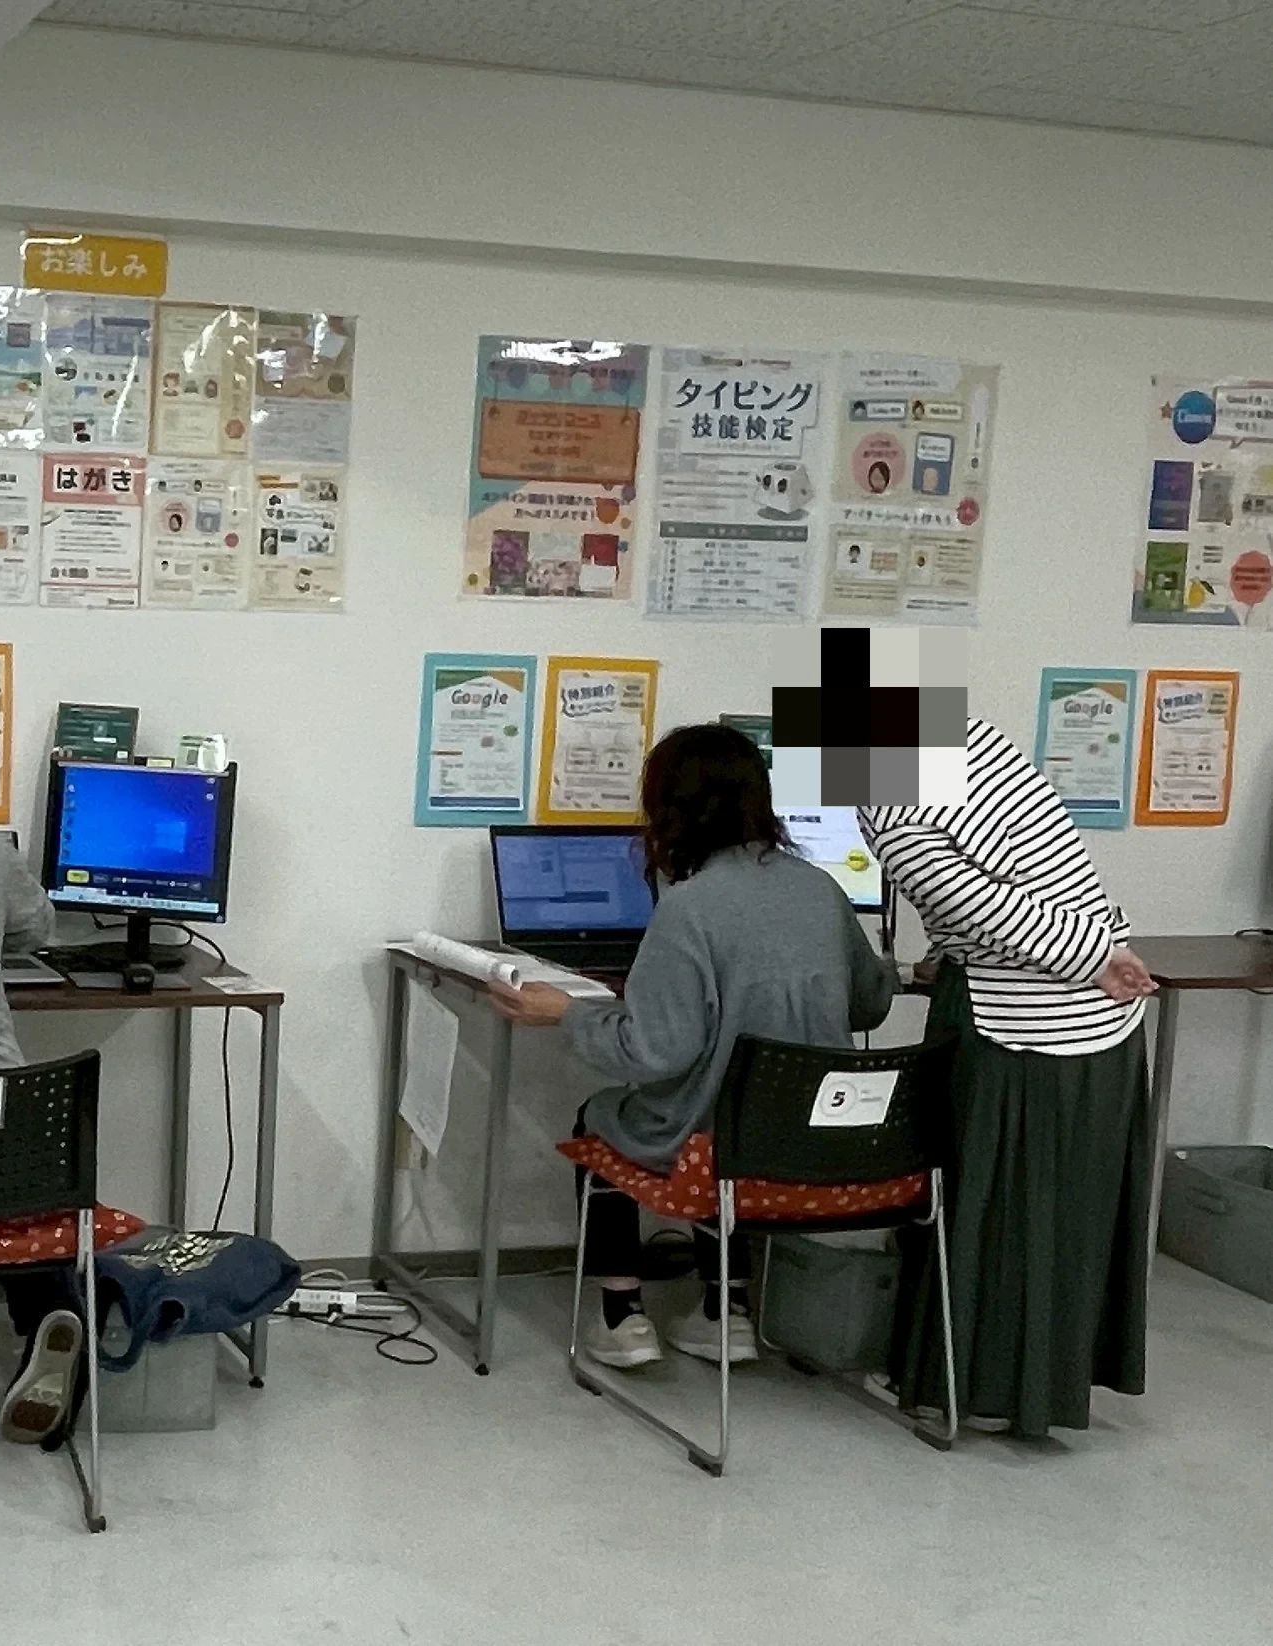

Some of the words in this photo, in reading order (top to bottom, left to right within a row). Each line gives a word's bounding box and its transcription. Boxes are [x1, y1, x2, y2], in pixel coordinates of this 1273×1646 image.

[39, 245, 148, 279] お楽しみ
[675, 378, 813, 412] タイピング
[692, 413, 794, 441] 技能検定
[56, 467, 132, 492] はがき
[451, 689, 509, 709] Google
[1063, 698, 1114, 718] Google
[831, 1091, 847, 1108] 5
